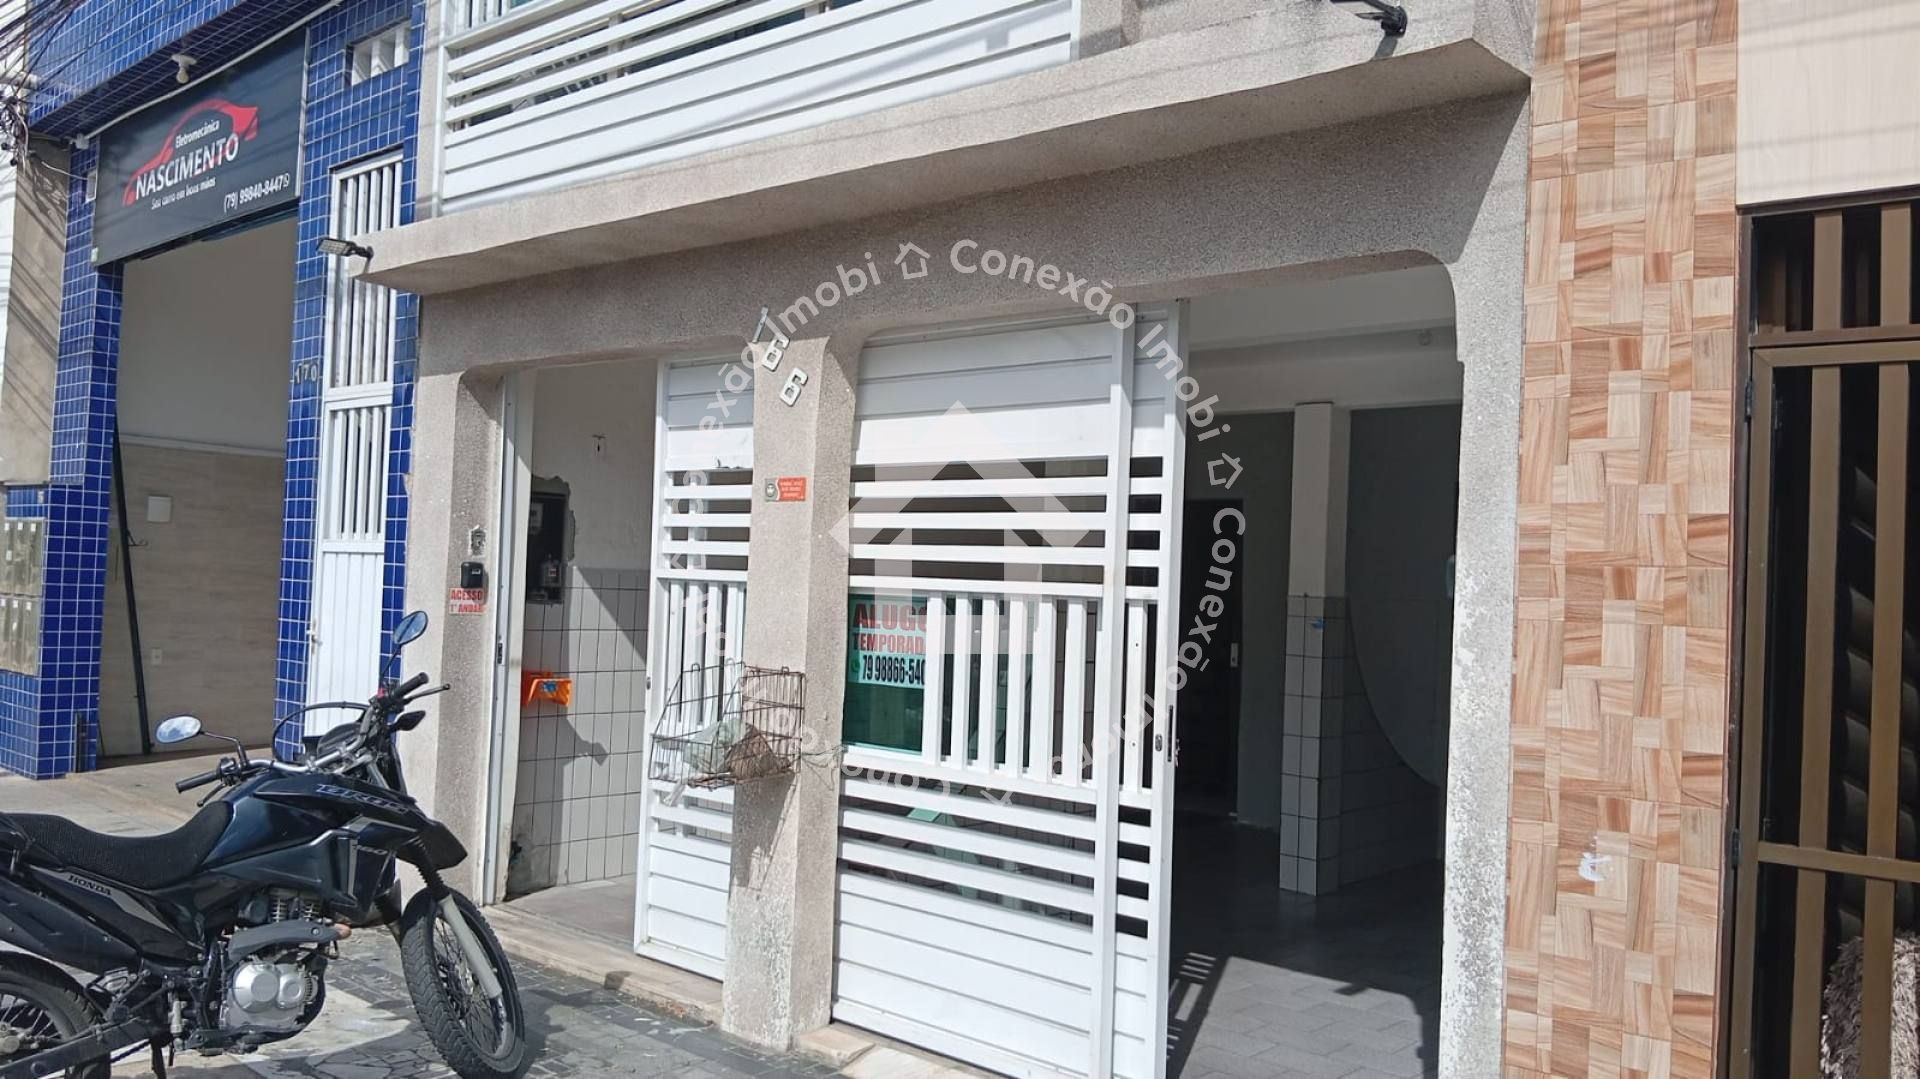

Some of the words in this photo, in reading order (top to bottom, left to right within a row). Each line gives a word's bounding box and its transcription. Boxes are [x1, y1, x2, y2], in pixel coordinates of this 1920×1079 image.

[175, 119, 220, 148] Eletromecânica
[135, 133, 239, 200] NASCIMENTO
[223, 192, 238, 213] (79)
[451, 589, 482, 600] ACESSO
[863, 655, 873, 680] 79
[69, 874, 111, 896] HONDA
